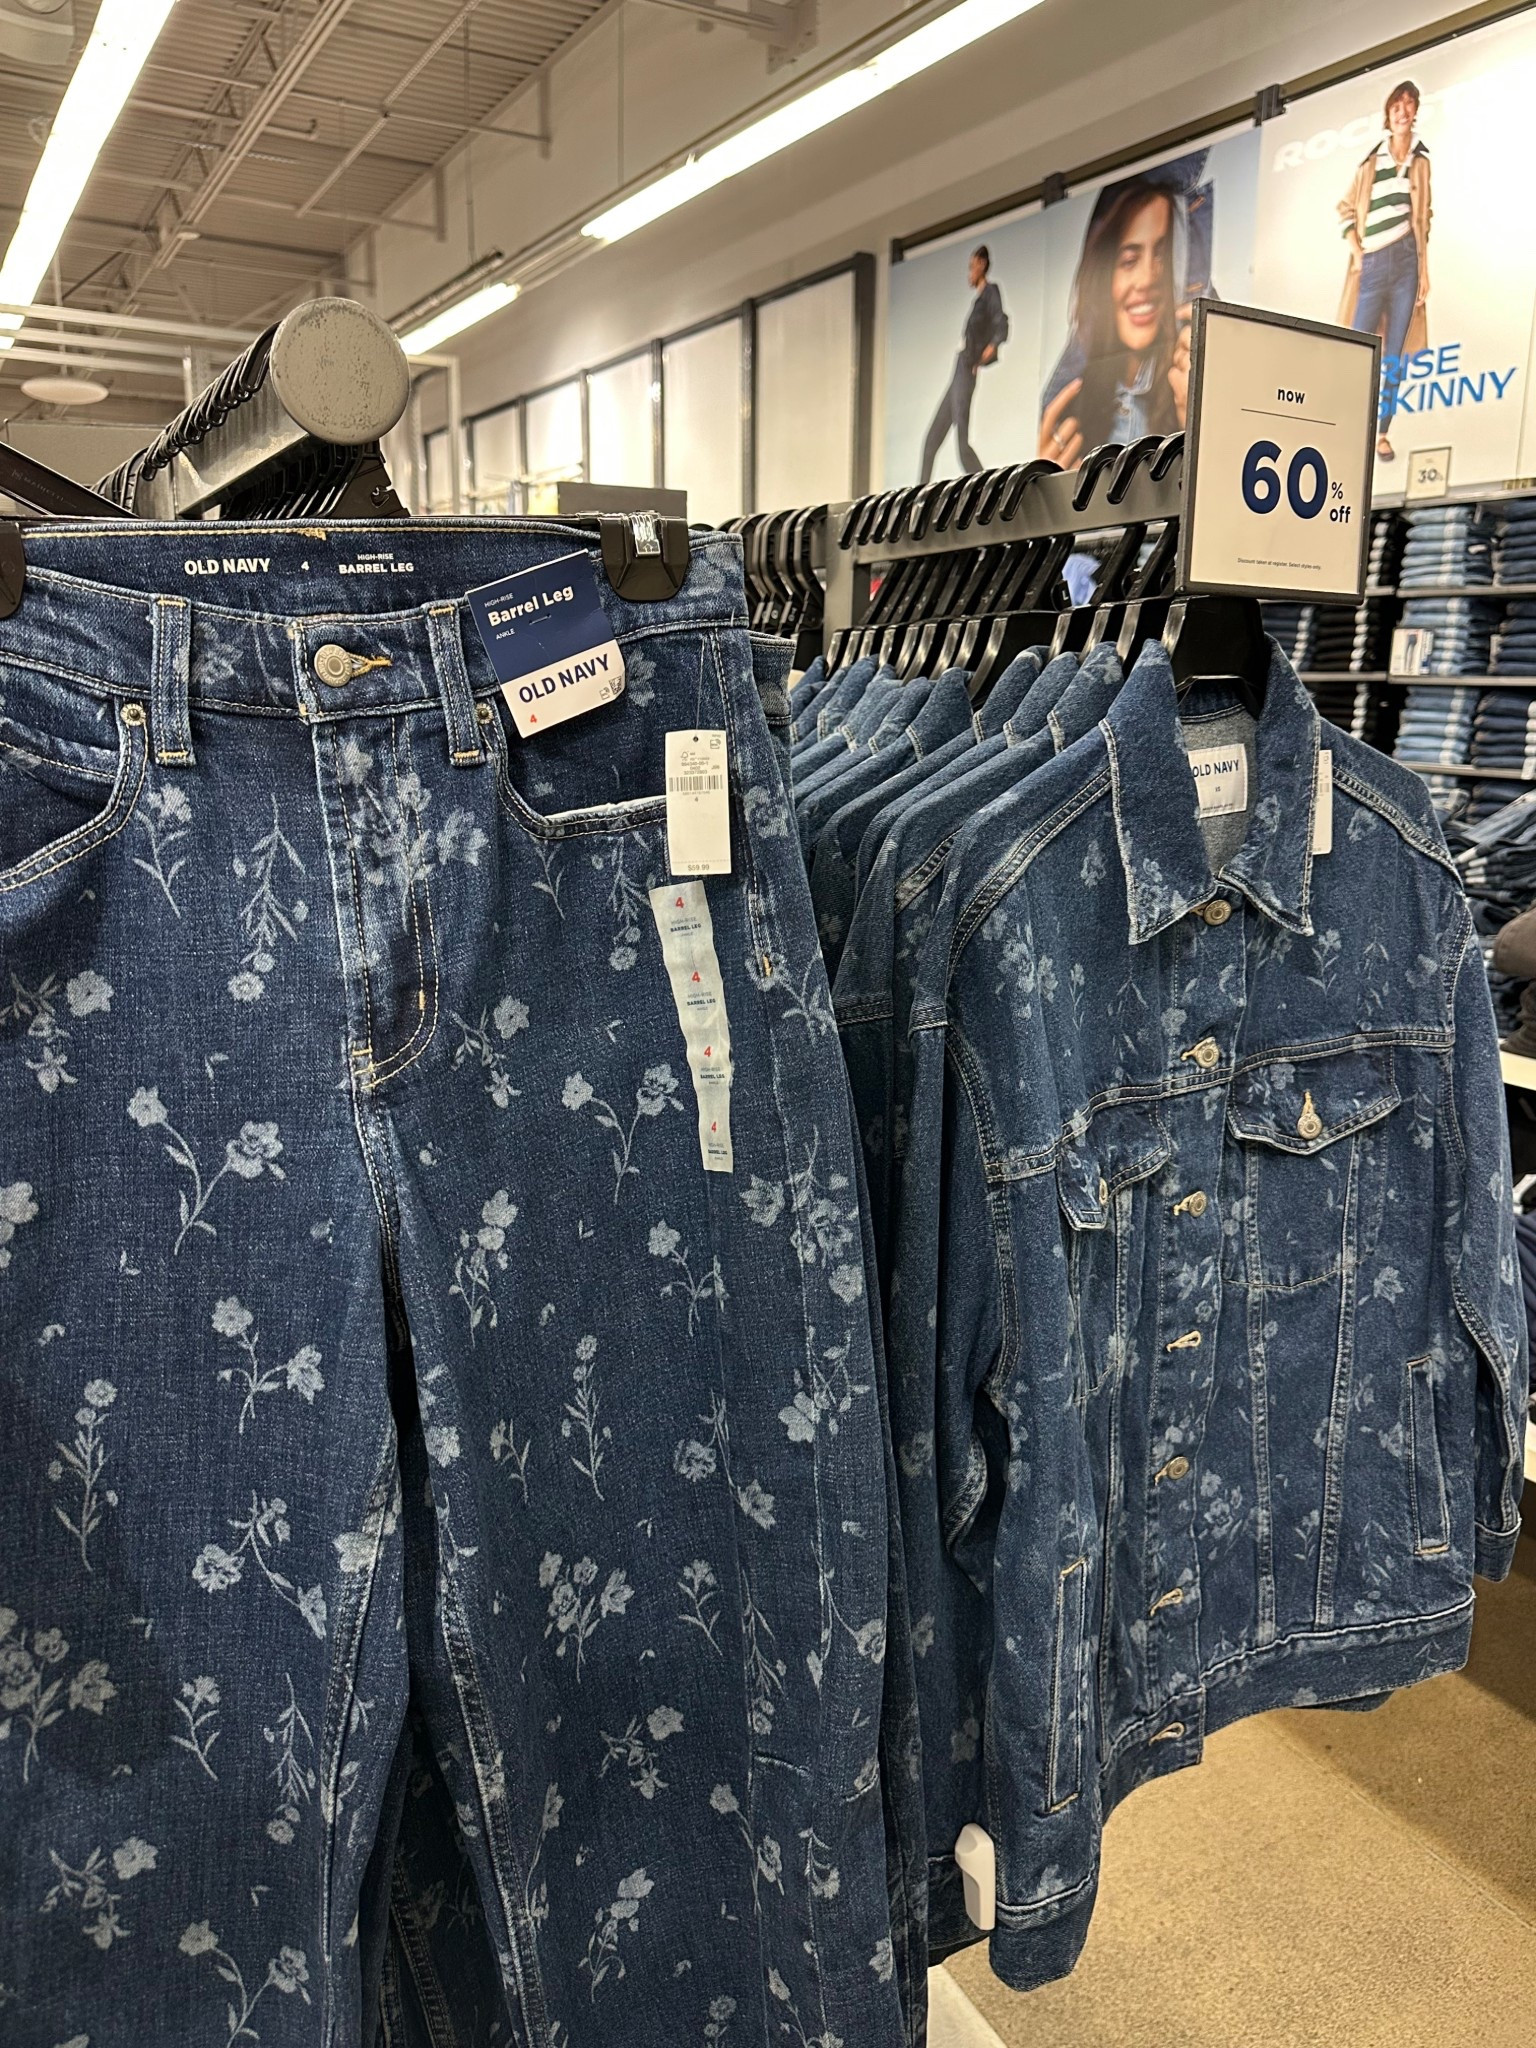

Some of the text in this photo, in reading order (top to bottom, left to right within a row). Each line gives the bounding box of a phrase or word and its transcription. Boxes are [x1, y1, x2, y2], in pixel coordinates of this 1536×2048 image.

[1277, 388, 1305, 404] now
[1329, 505, 1351, 523] off
[184, 558, 270, 575] OLD NAVY
[301, 561, 310, 571] 4
[338, 562, 414, 574] BARREL LEG
[484, 592, 514, 608] HIGH-RISE
[488, 585, 574, 627] Barrel Leg
[495, 628, 515, 640] ANKLE
[519, 653, 610, 703] OLD NAVY
[529, 714, 538, 724] 4
[1193, 759, 1240, 778] OLD NAVY
[675, 897, 685, 909] 4
[670, 925, 691, 933] BARREL
[691, 971, 701, 983] 4
[704, 1046, 712, 1057] 4
[711, 1121, 717, 1133] 4
